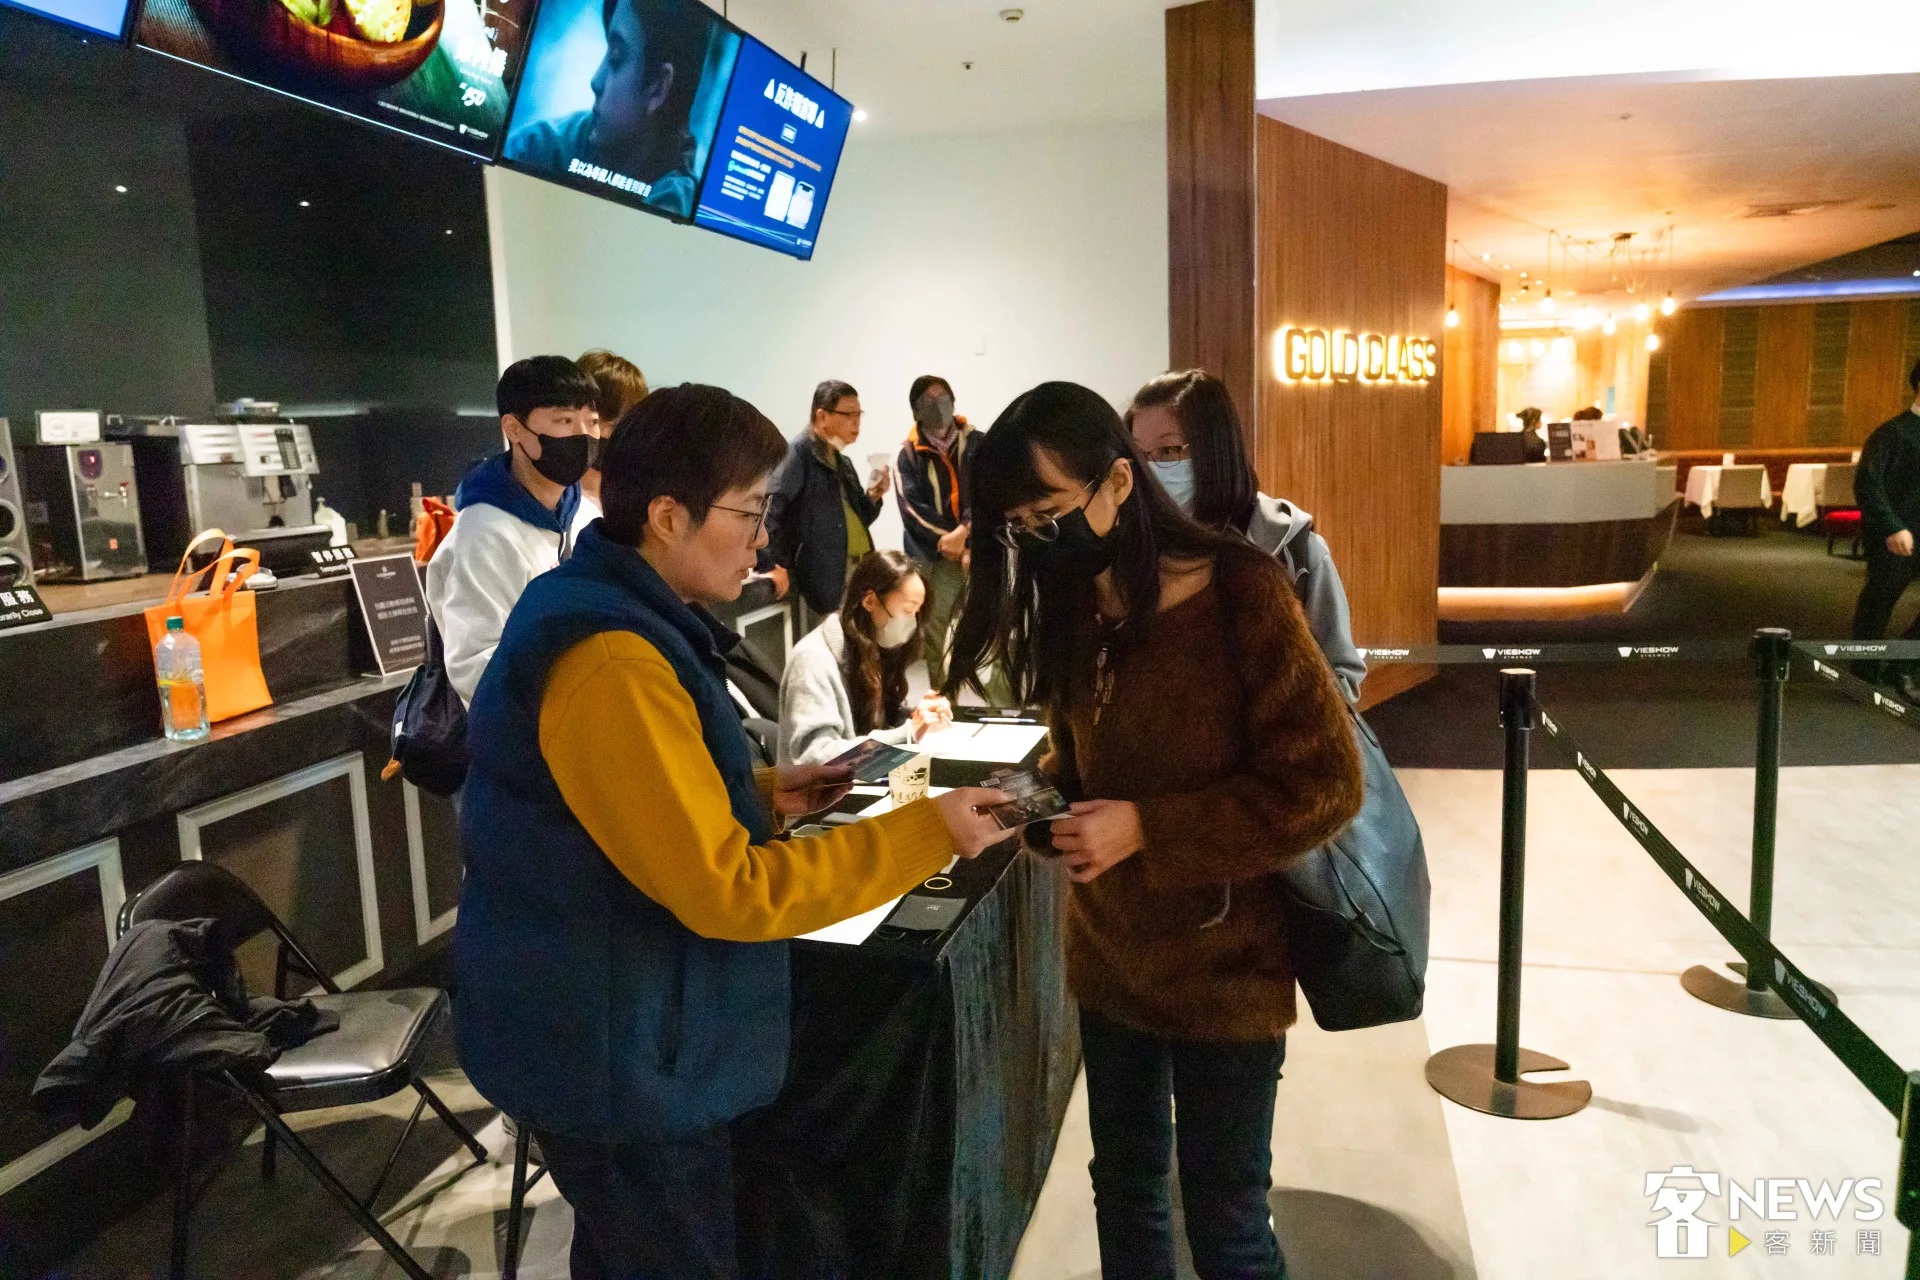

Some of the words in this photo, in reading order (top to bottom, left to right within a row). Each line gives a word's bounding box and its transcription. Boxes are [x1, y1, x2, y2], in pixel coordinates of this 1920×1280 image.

[1284, 327, 1359, 381] GOLD
[1363, 333, 1437, 382] CLASS
[1368, 648, 1410, 656] VIESHOW
[1497, 648, 1541, 656] VIESHOW
[1633, 646, 1679, 654] VIESHOW
